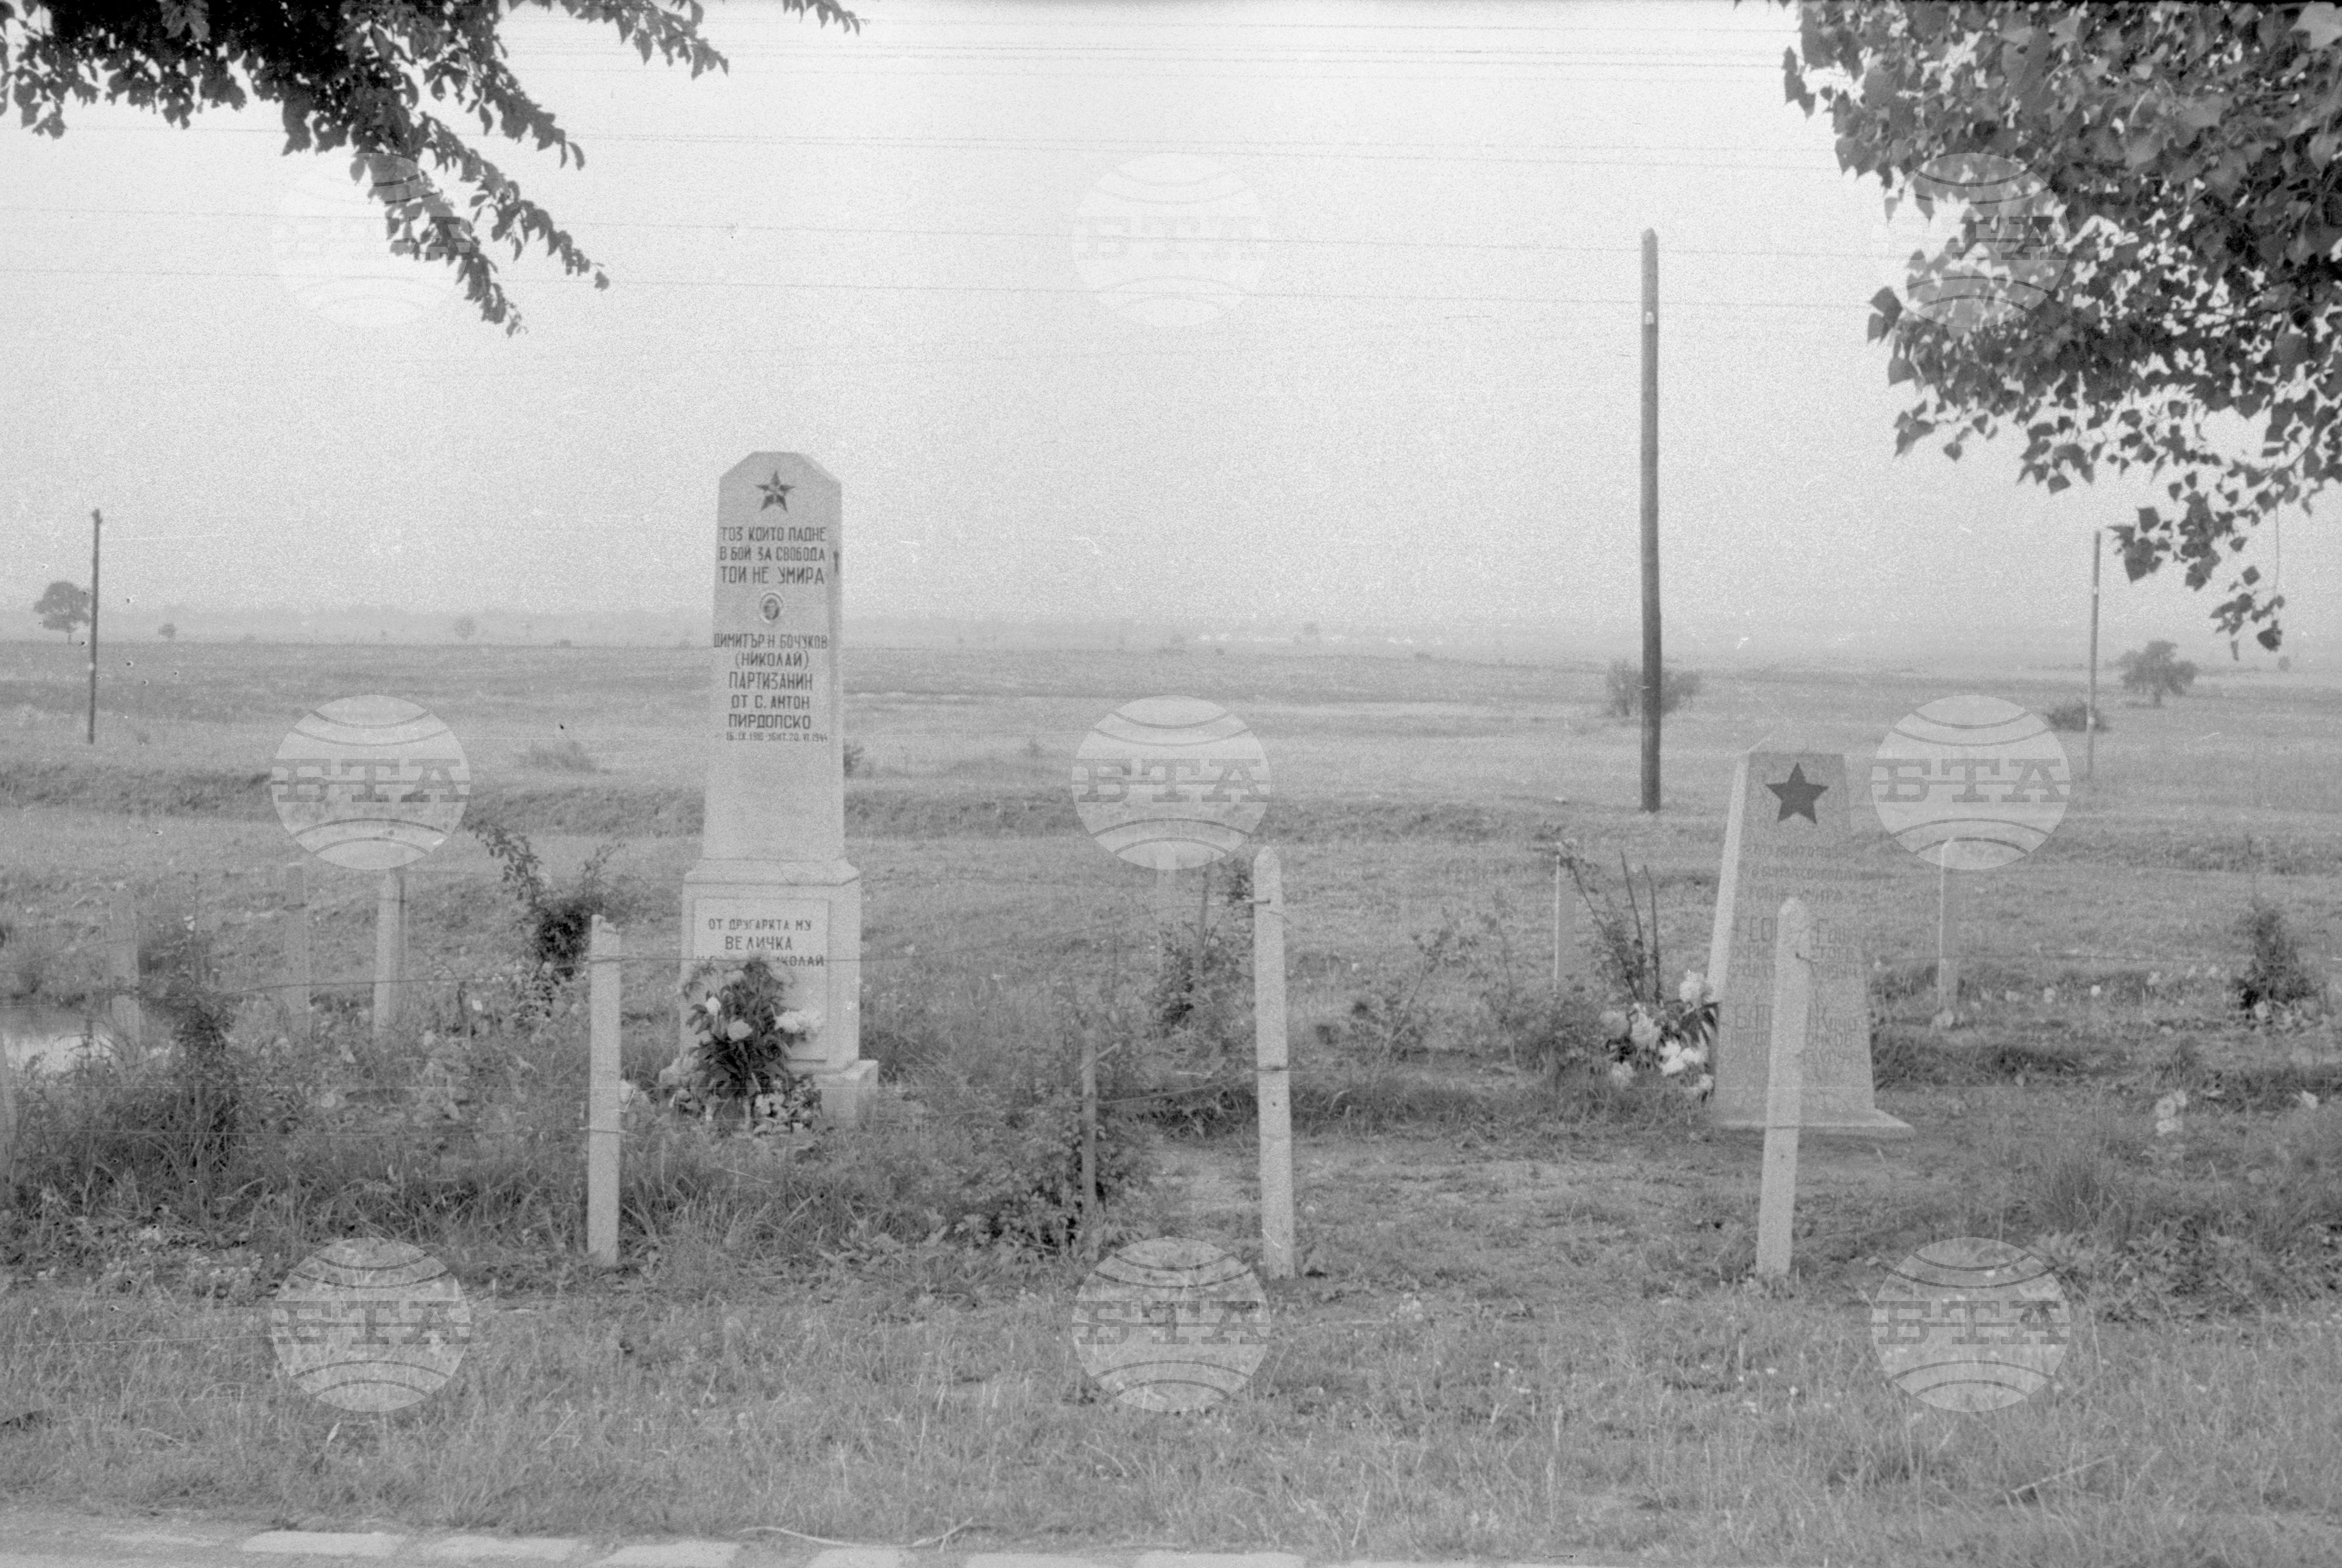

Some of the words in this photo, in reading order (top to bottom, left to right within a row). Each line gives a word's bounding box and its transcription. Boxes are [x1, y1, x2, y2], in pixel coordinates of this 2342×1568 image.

[721, 527, 743, 541] ТОЗ
[789, 527, 826, 542] ПАДНЕ
[720, 547, 727, 560] В
[758, 547, 772, 561] ЗА
[776, 547, 825, 562] СВОБОДА
[753, 566, 769, 584] НЕ
[777, 566, 824, 584] УМИРА
[714, 634, 765, 648] ДИМИТЪР
[780, 634, 828, 649] БОЧУКОВ
[735, 650, 809, 670] (НИКОЛАЙ)
[730, 672, 813, 690] ПАРТИЗАНИН
[732, 695, 748, 708] ОТ
[755, 695, 766, 708] С.
[771, 696, 809, 709] АНТОН
[729, 713, 811, 730] ПИРДОПСКО
[708, 918, 723, 930] ОТ
[729, 919, 789, 931] ДРУГАРКТА
[796, 919, 812, 931] МУ
